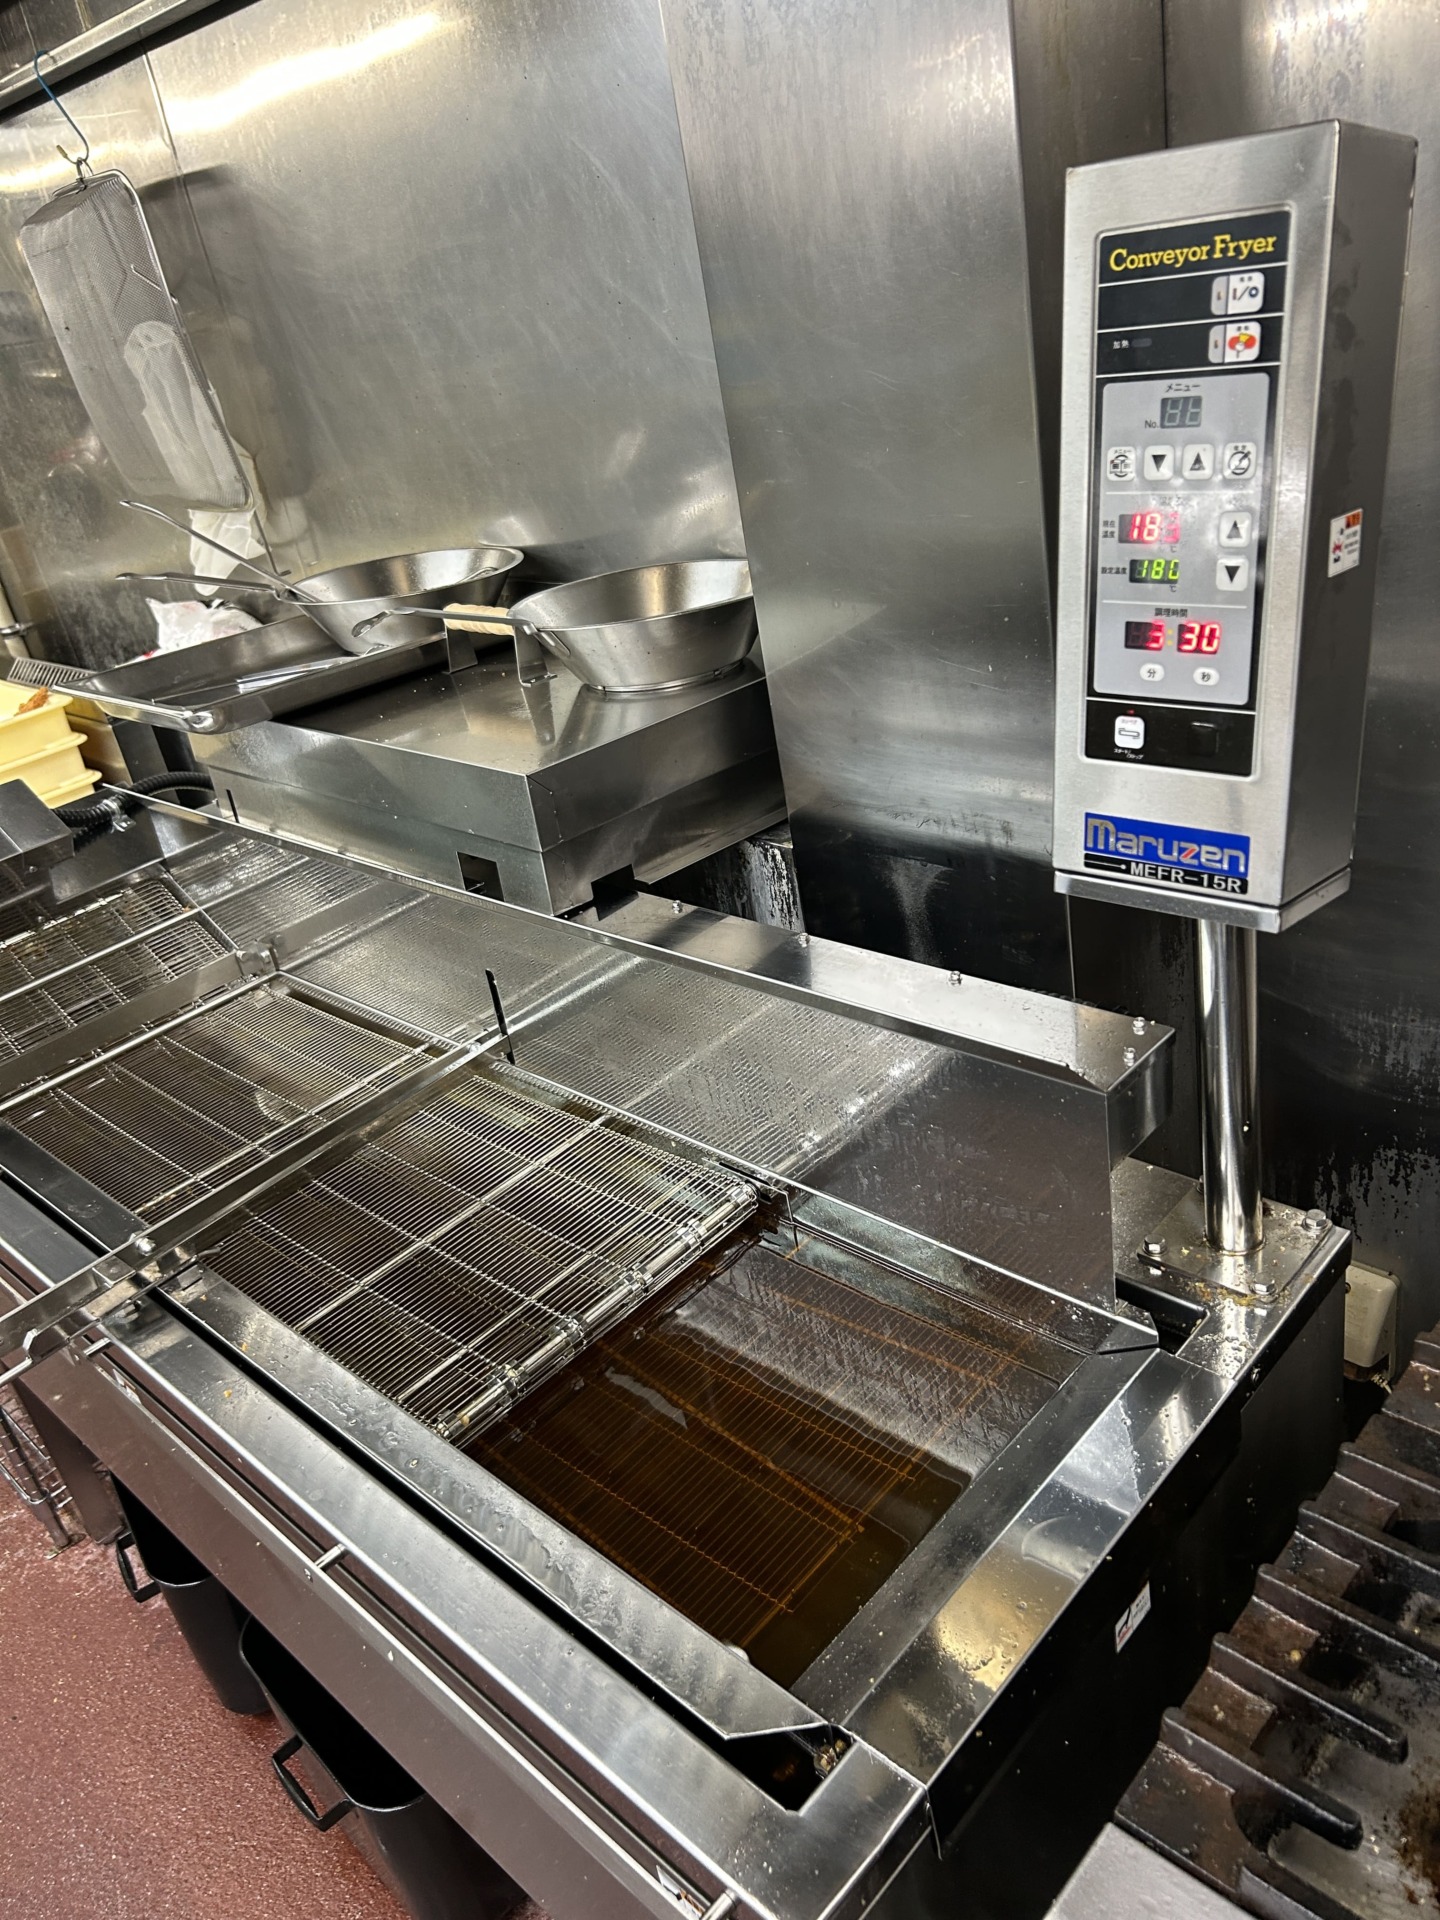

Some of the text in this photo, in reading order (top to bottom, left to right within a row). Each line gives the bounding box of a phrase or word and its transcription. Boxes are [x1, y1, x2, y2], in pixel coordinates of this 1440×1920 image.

[1109, 234, 1277, 271] Conveyor Fryer
[1113, 340, 1130, 349] 加熱
[1165, 383, 1201, 393] メニュー
[1154, 608, 1188, 617] 調理時間
[1147, 669, 1156, 678] 分
[1201, 672, 1211, 682] 秒
[1130, 861, 1242, 893] MEFR-15R
